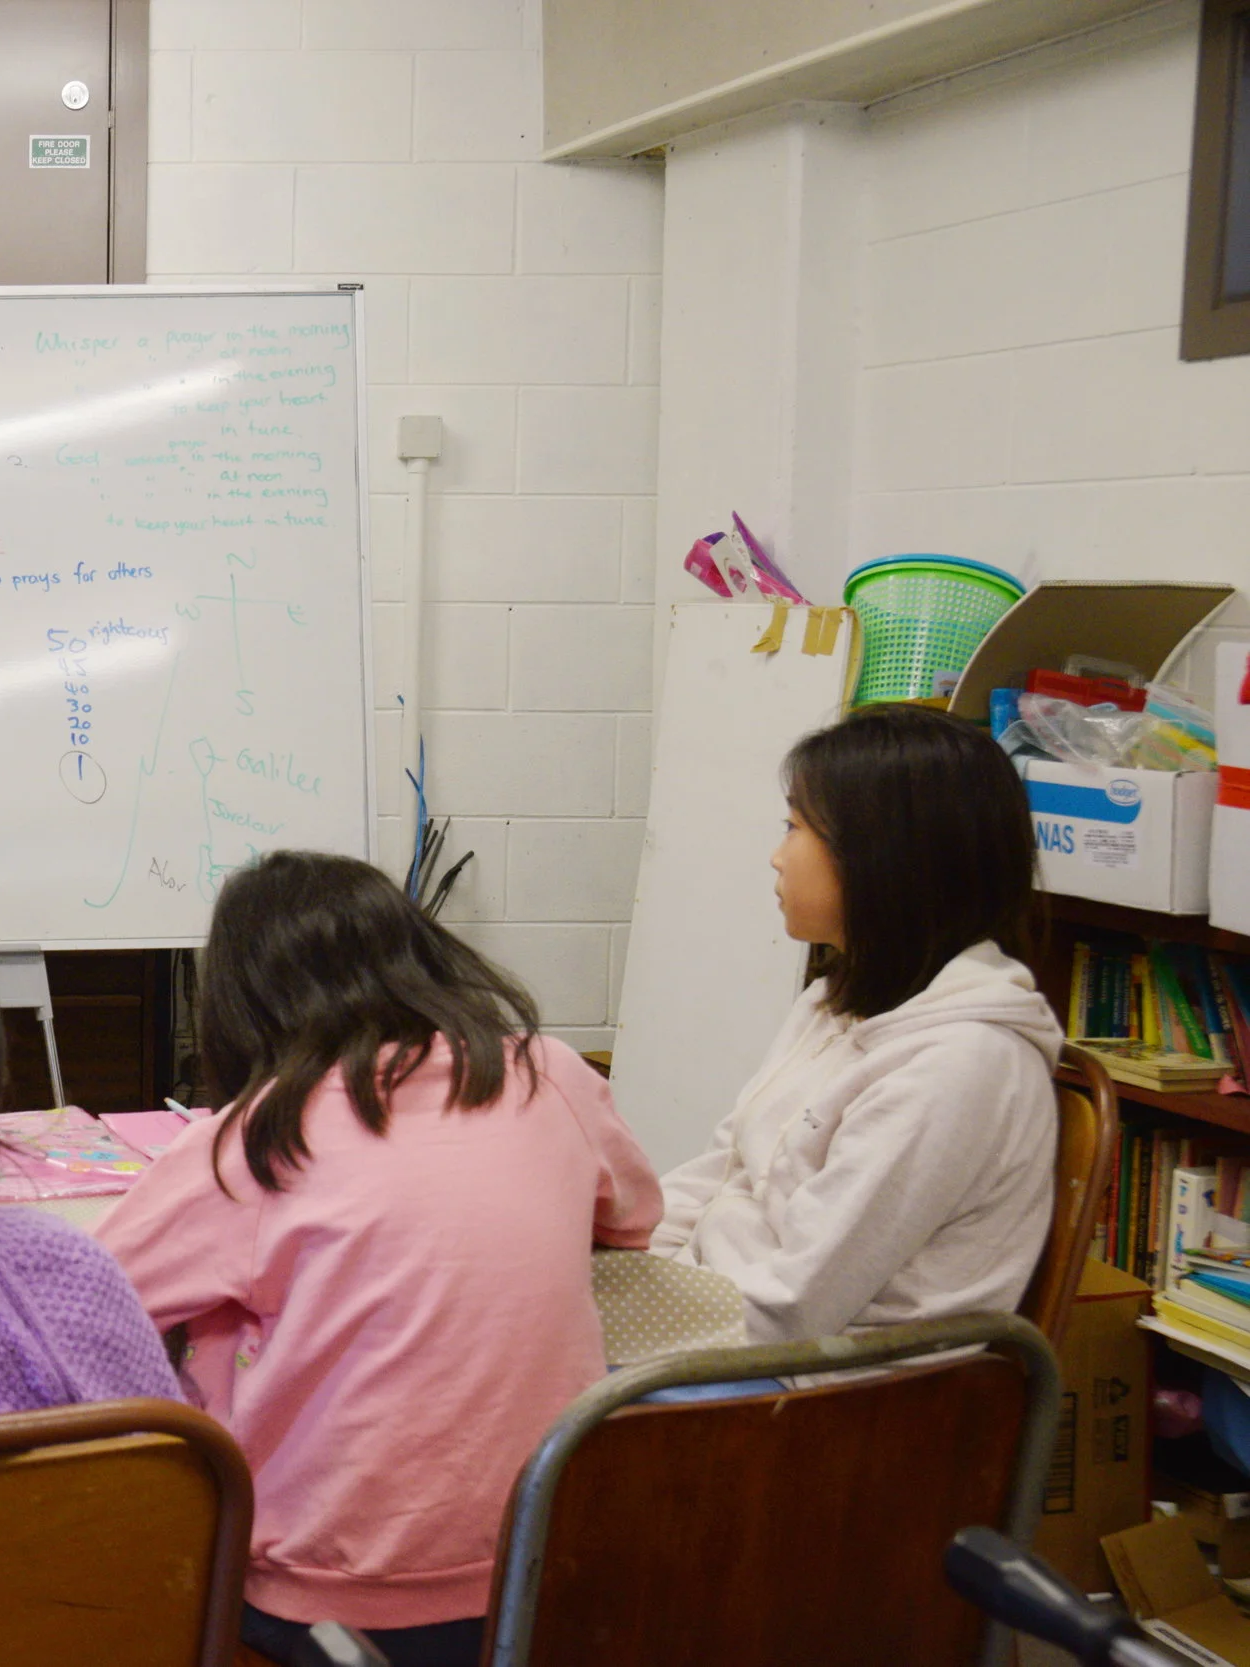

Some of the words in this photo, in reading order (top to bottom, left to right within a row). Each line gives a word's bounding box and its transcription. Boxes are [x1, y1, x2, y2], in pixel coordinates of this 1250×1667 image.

[38, 140, 55, 148] FIRE
[57, 140, 80, 148] DOOR
[36, 331, 121, 356] Whisper
[247, 325, 278, 339] the
[288, 323, 351, 350] morning
[269, 364, 337, 387] evening
[56, 443, 100, 467] God
[211, 450, 243, 463] the
[252, 450, 322, 473] morning
[247, 472, 283, 482] noon
[261, 486, 329, 509] evening
[134, 516, 170, 535] keep
[12, 571, 62, 593] prays
[73, 561, 97, 585] for
[108, 561, 153, 581] others
[46, 627, 87, 654] 50
[88, 616, 171, 646] righteous
[63, 679, 90, 696] 40
[66, 698, 93, 714] 30
[67, 716, 93, 731] 20
[69, 732, 90, 747] 10
